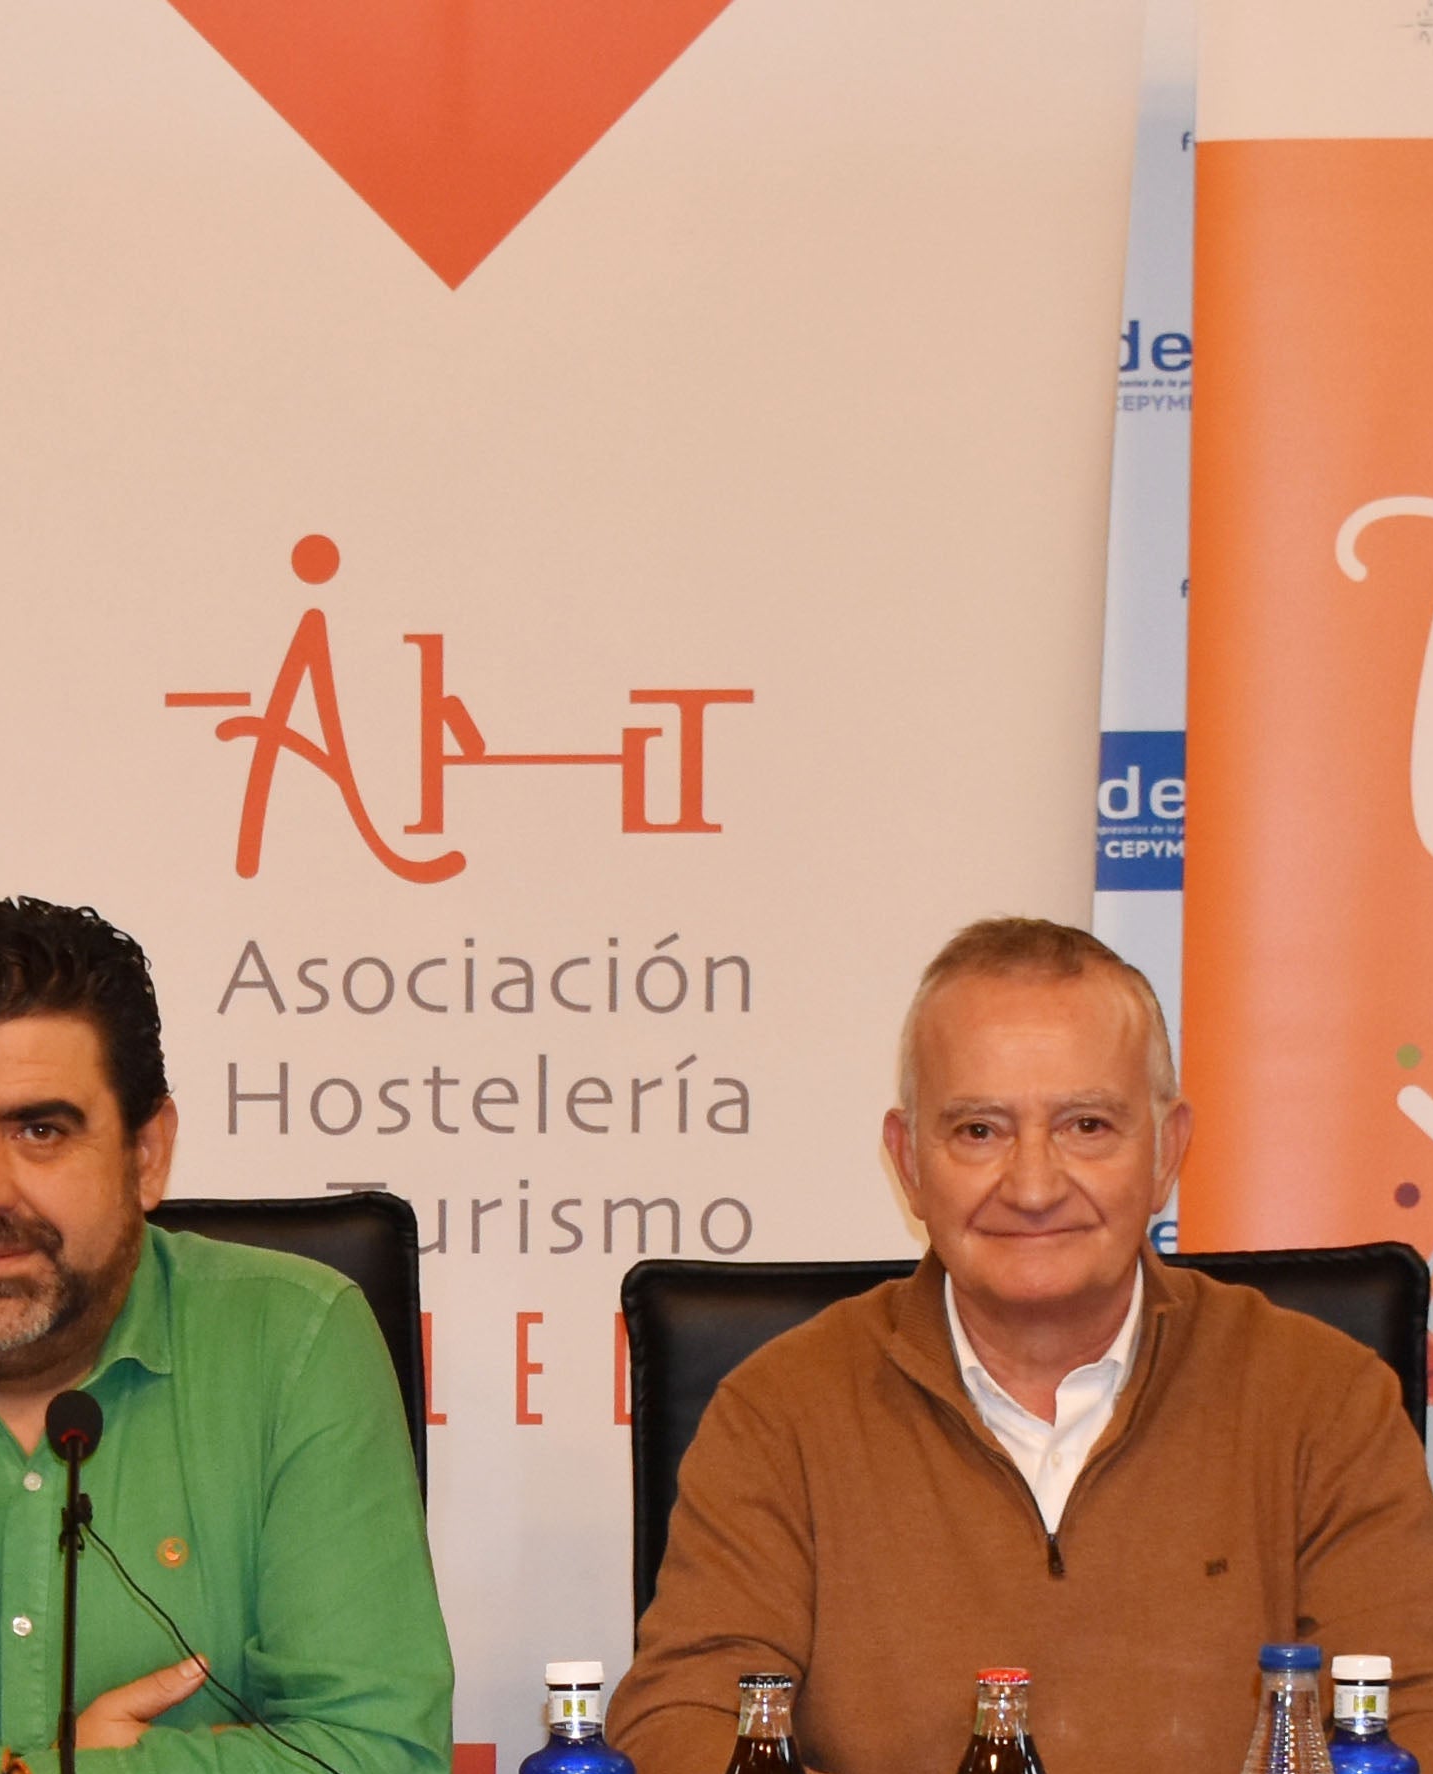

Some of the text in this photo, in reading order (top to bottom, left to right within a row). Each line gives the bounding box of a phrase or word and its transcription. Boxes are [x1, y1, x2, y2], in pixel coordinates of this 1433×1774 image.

[217, 933, 750, 1014] Asociación
[228, 1054, 749, 1135] Hostelería
[326, 1179, 755, 1256] urismo
